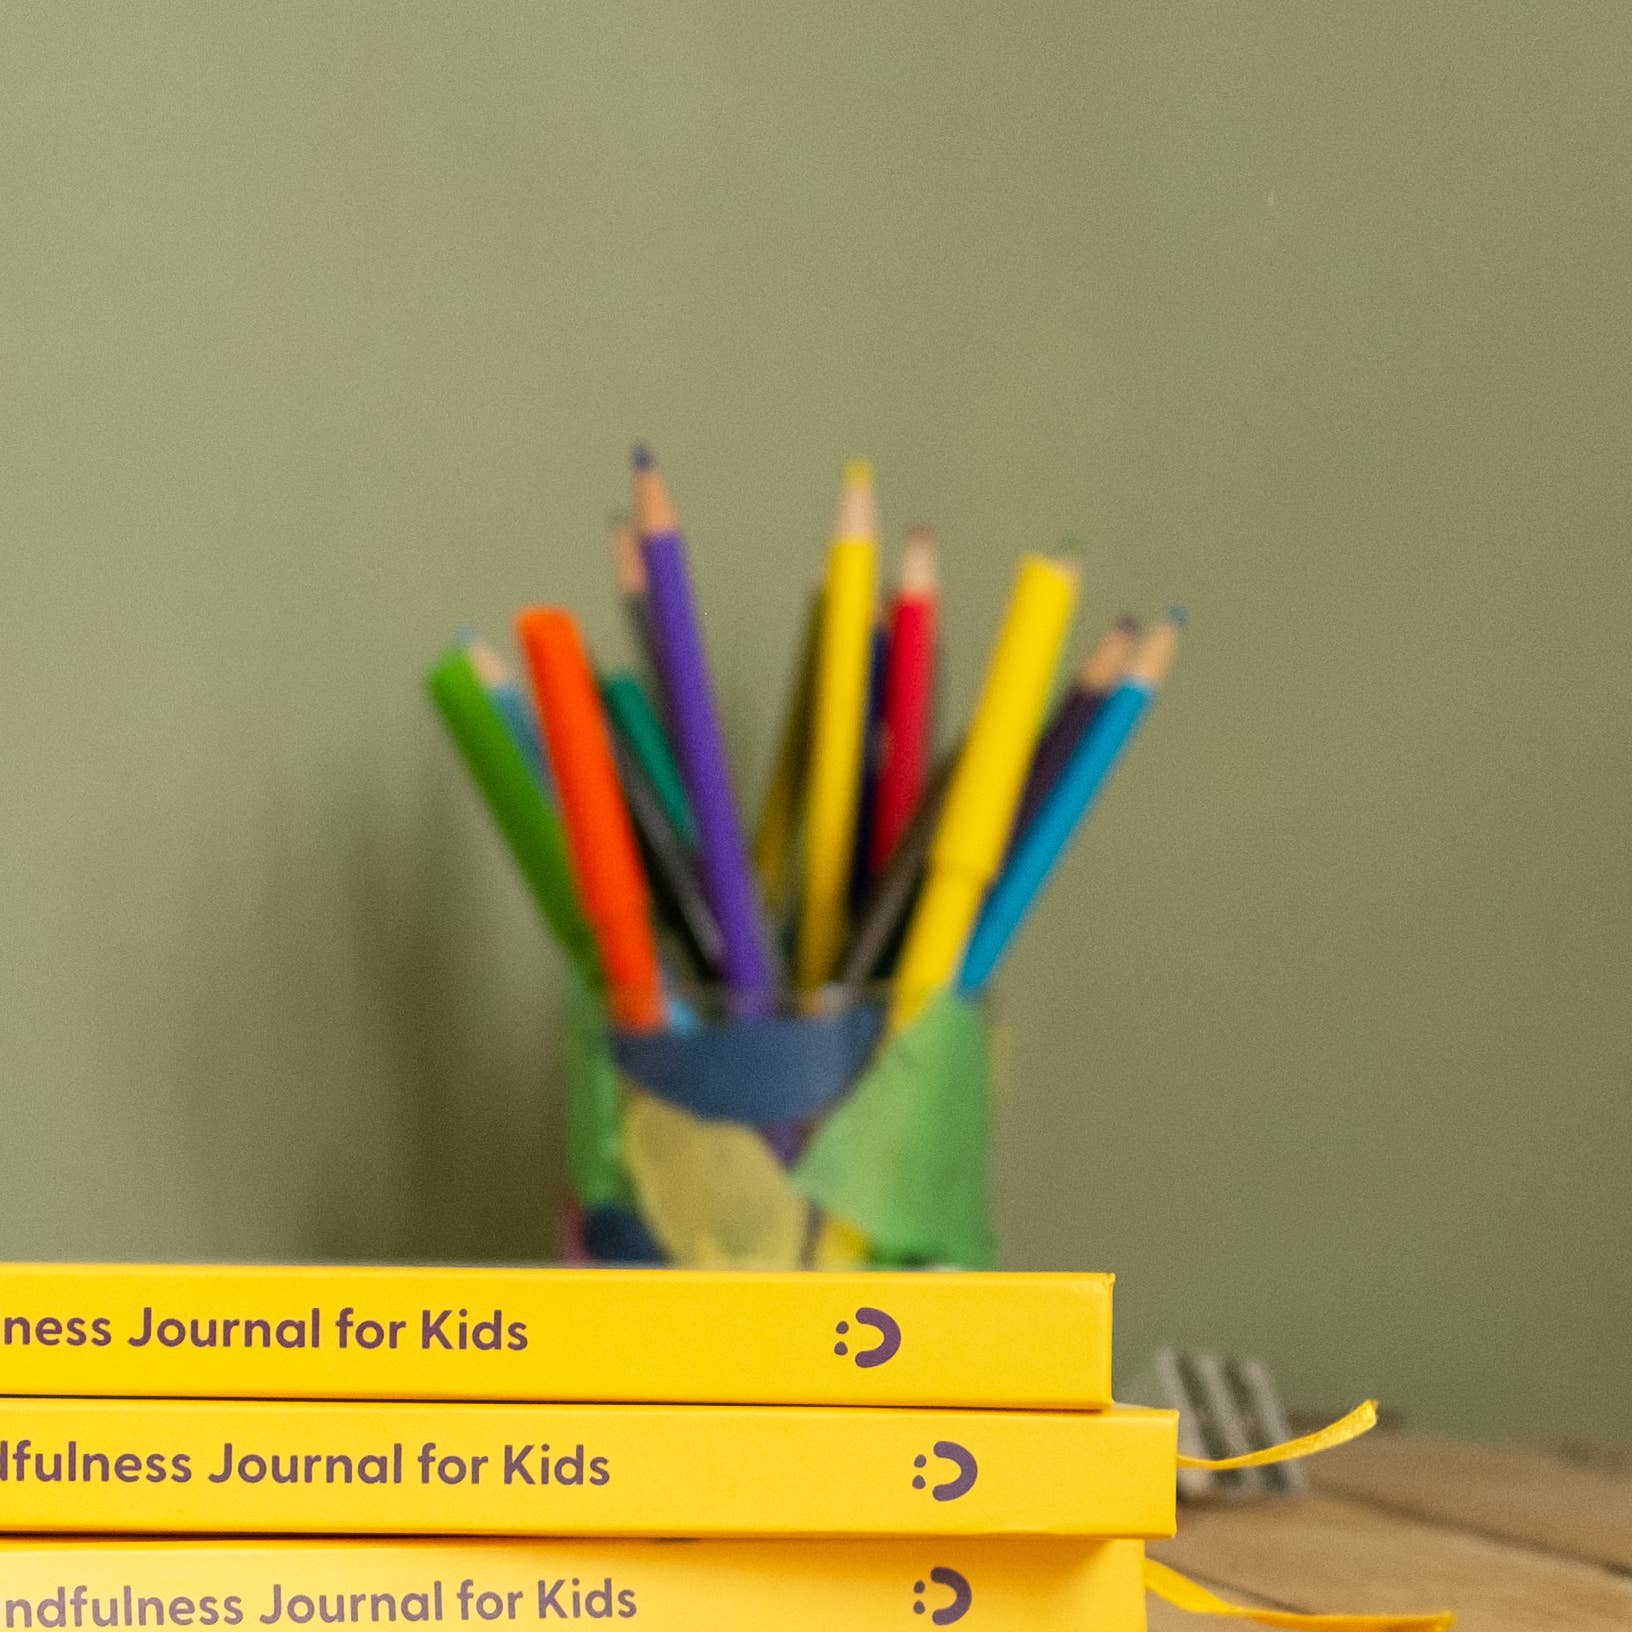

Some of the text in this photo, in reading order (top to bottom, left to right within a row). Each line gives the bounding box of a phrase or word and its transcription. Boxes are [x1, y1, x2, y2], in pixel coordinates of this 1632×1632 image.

[128, 1306, 321, 1349] Journal
[335, 1307, 407, 1350] for
[421, 1308, 529, 1352] Kids
[208, 1442, 403, 1485] Journal
[417, 1442, 489, 1486] for
[503, 1443, 611, 1487] Kids
[258, 1579, 444, 1626] Journal
[456, 1578, 524, 1622] for
[536, 1577, 638, 1620] Kids
